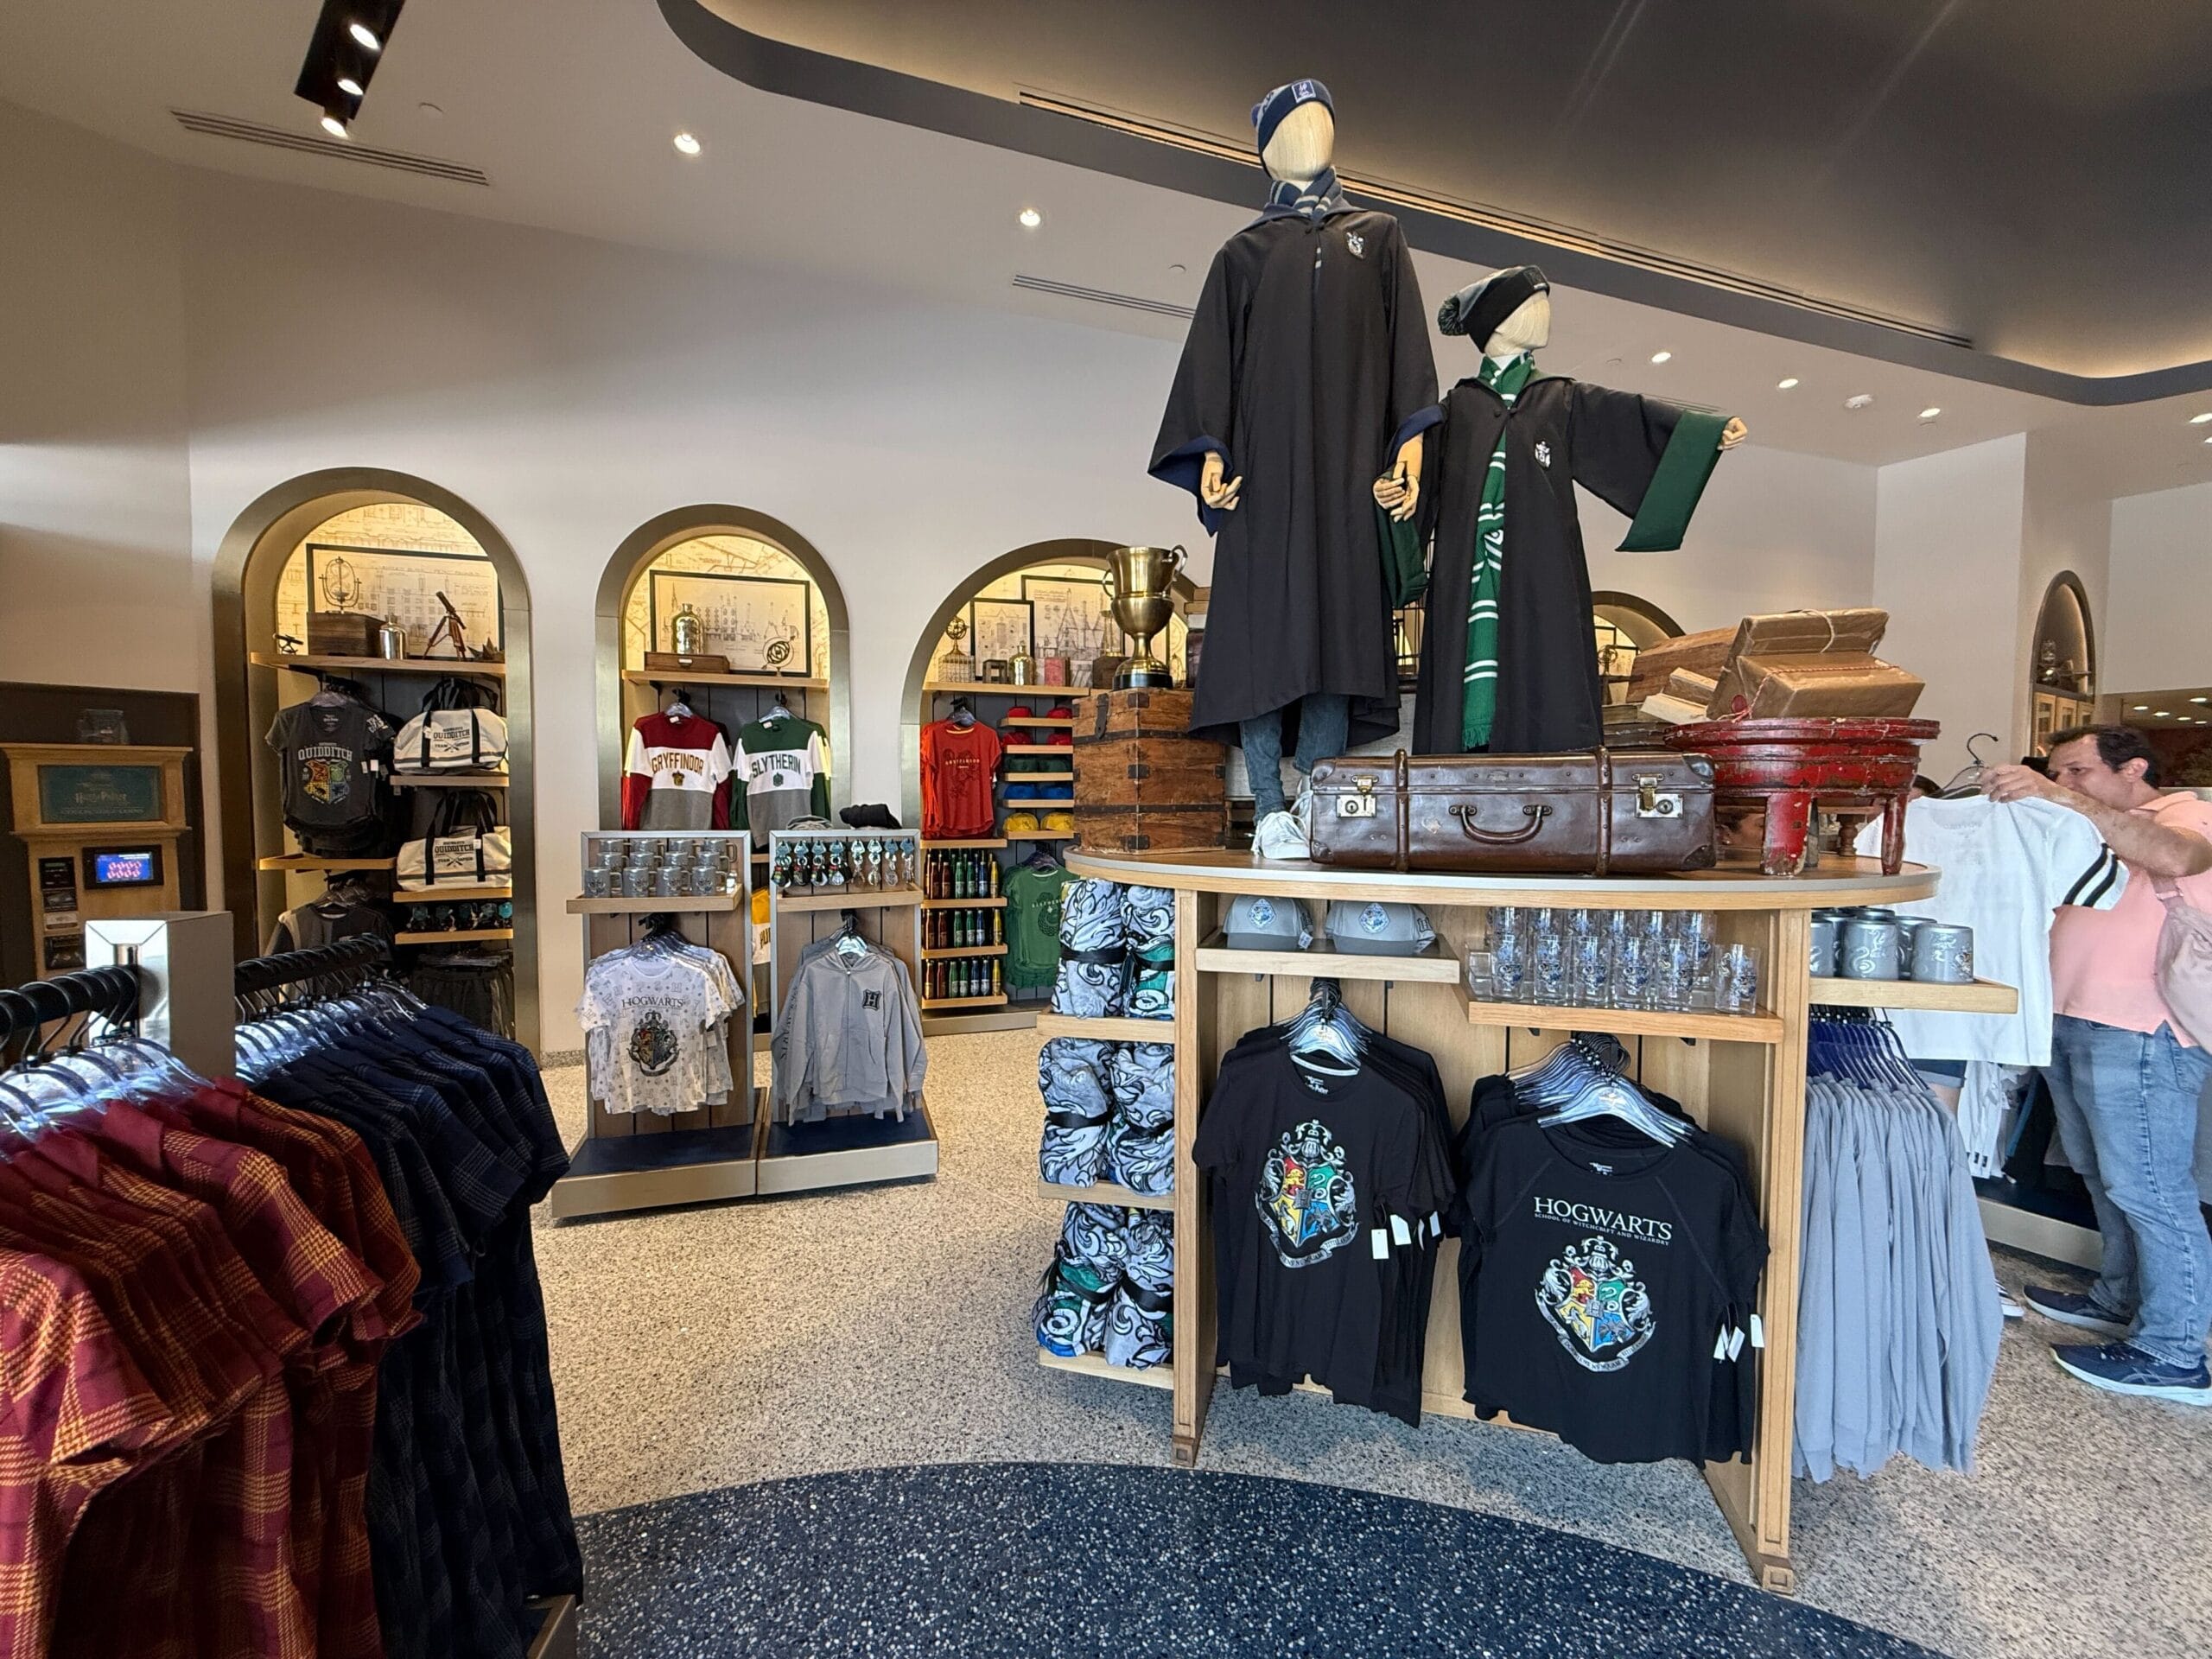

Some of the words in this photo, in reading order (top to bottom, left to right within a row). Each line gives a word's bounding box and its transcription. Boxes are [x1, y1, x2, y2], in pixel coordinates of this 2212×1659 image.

[433, 729, 470, 740] QUIDDITCH
[297, 746, 353, 762] QUIDDITCH
[652, 753, 704, 775] GRYFFINDOR
[751, 753, 802, 779] SLYTHERIN
[434, 844, 474, 855] QUIDDITCH
[622, 995, 684, 1008] HOGWARTS
[1534, 1196, 1673, 1241] HOGWARTS
[1534, 1212, 1560, 1222] SCHOOL
[1573, 1220, 1615, 1234] WITCHCRAFT
[1634, 1234, 1670, 1246] WIZARDRY
